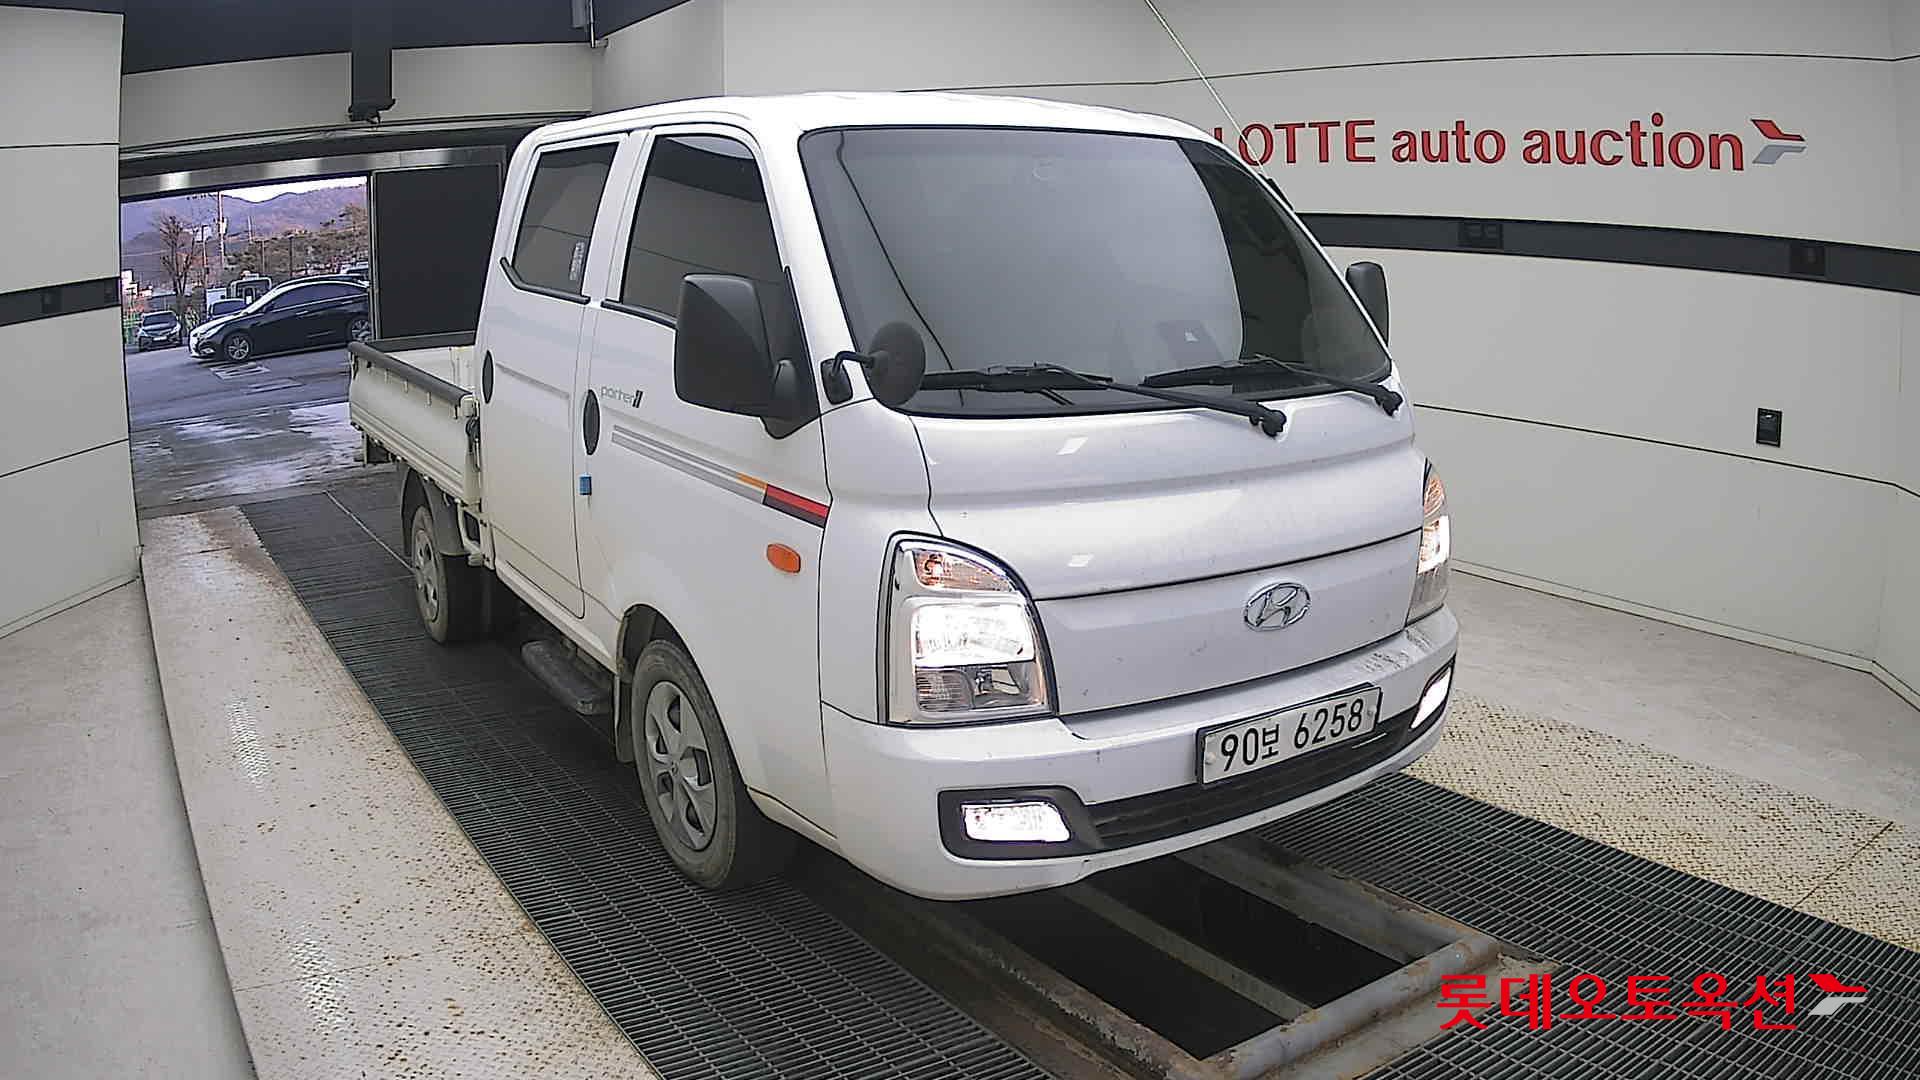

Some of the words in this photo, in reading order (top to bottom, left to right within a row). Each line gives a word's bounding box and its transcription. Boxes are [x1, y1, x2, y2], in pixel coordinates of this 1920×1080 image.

[1392, 120, 1506, 164] auto
[1523, 112, 1745, 171] auction
[1221, 723, 1280, 772] 90보
[1294, 698, 1364, 749] 6258
